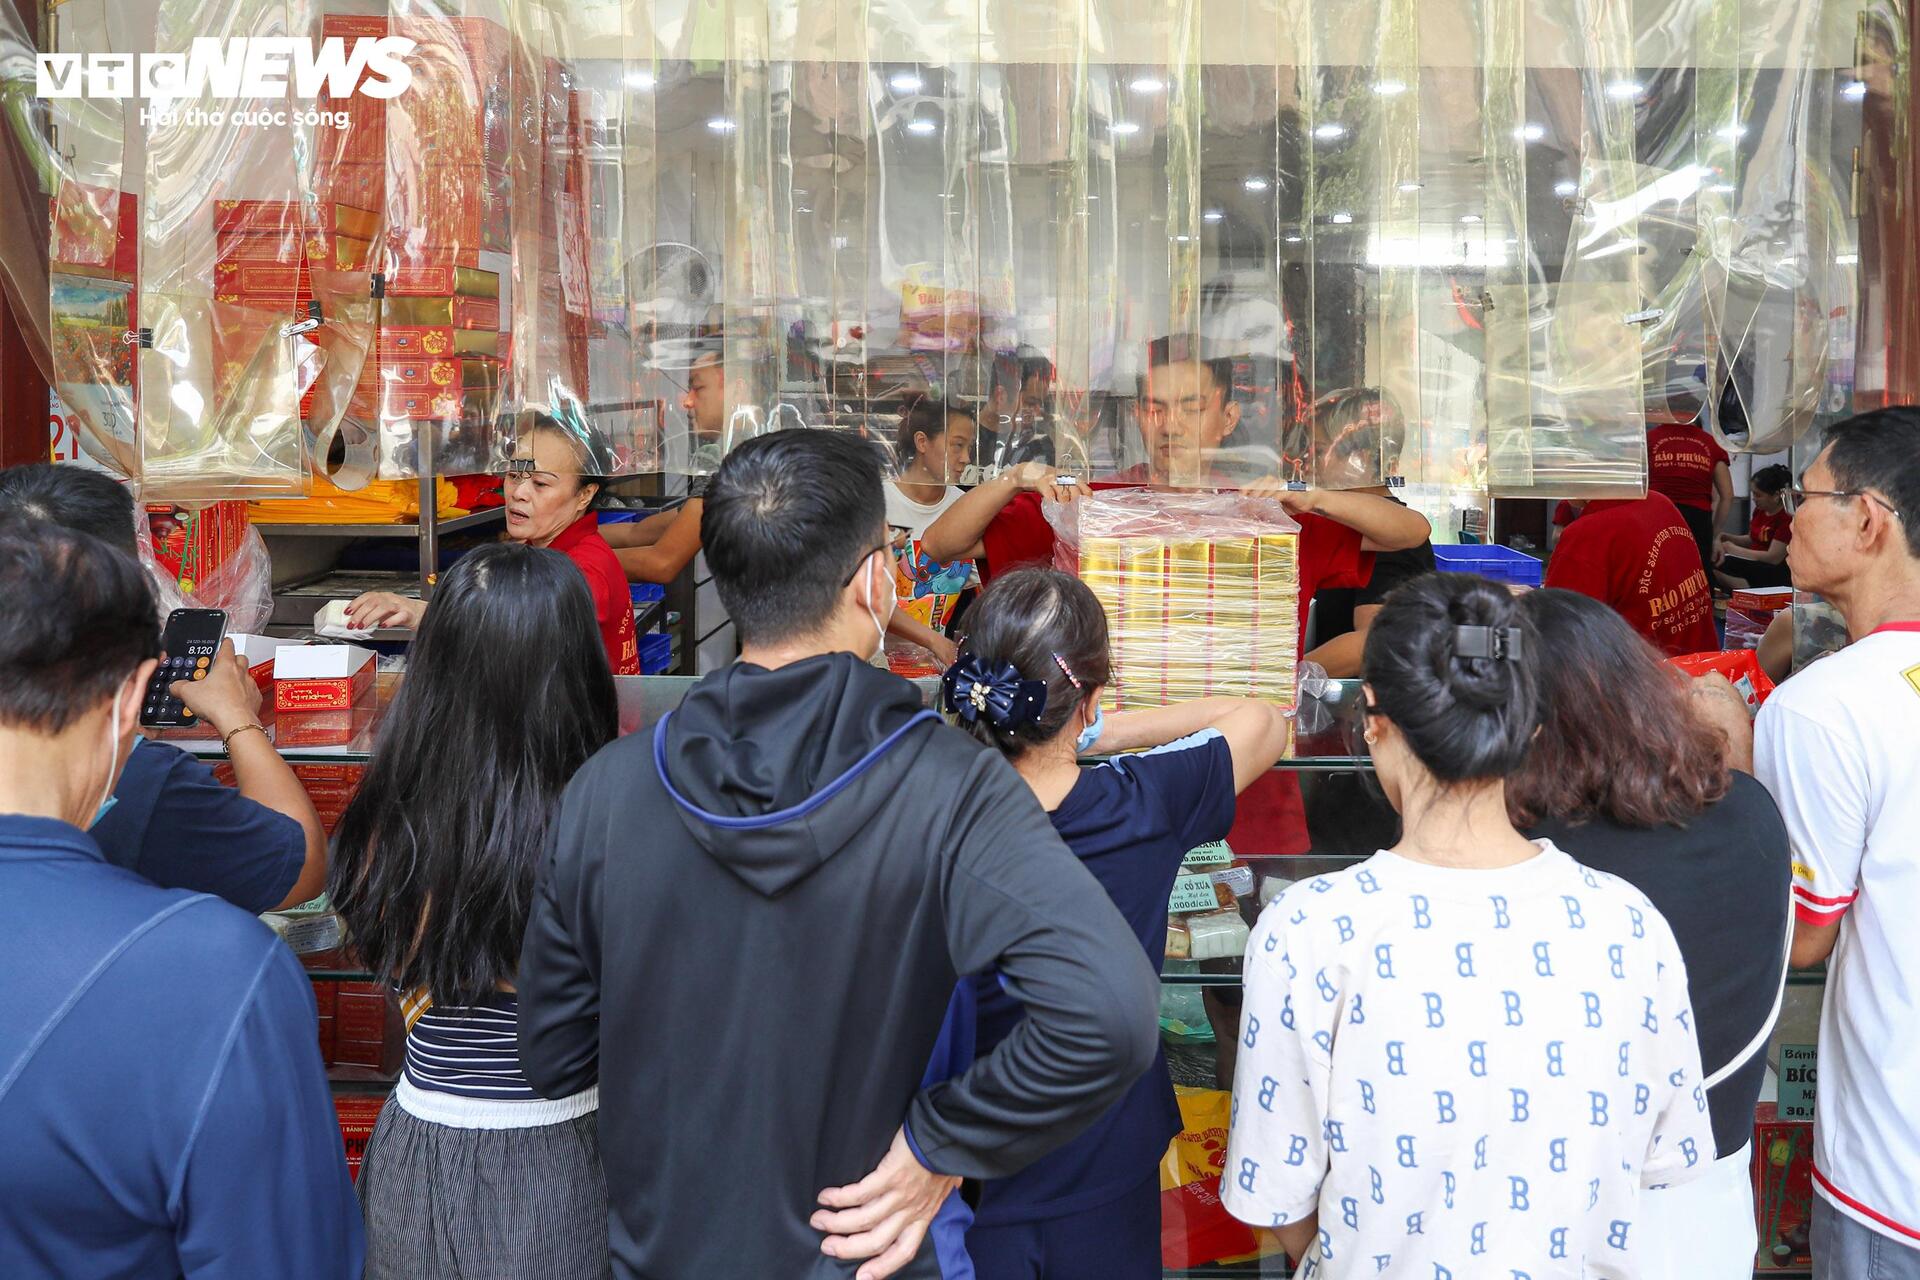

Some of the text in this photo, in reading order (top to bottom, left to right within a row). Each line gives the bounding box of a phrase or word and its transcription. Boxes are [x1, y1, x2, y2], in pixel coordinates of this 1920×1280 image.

[188, 645, 213, 655] 8.120
[1410, 895, 1431, 928] B
[1490, 896, 1510, 928] B
[1562, 896, 1585, 928] B
[1627, 904, 1645, 938] B
[1334, 916, 1354, 943] B
[1375, 944, 1395, 979] B
[1456, 943, 1476, 977] B
[1533, 942, 1553, 976] B
[1608, 944, 1624, 979] B
[1423, 992, 1444, 1028] B
[1503, 991, 1523, 1026] B
[1581, 992, 1602, 1028] B
[1242, 1012, 1260, 1049] B
[1386, 1041, 1407, 1076] B
[1468, 1041, 1487, 1077] B
[1546, 1041, 1565, 1077] B
[1618, 1042, 1630, 1077] B
[1785, 1049, 1818, 1060] Bánh
[1258, 1075, 1279, 1112] B
[1358, 1079, 1376, 1115] B
[1434, 1091, 1456, 1124] B
[1511, 1088, 1529, 1122] B
[1588, 1091, 1608, 1126] B
[1634, 1083, 1650, 1115] B
[346, 1125, 363, 1133] BÁNH
[1326, 1119, 1349, 1152] B
[1285, 1135, 1308, 1166] B
[1396, 1135, 1418, 1168] B
[1474, 1136, 1487, 1169] B
[1549, 1138, 1567, 1173] B
[1680, 1137, 1698, 1168] B
[1238, 1158, 1260, 1193] B
[1509, 1176, 1529, 1211] B
[1341, 1196, 1358, 1231] B
[1471, 1222, 1487, 1255] B
[1549, 1227, 1568, 1259] B
[1606, 1220, 1632, 1251] B
